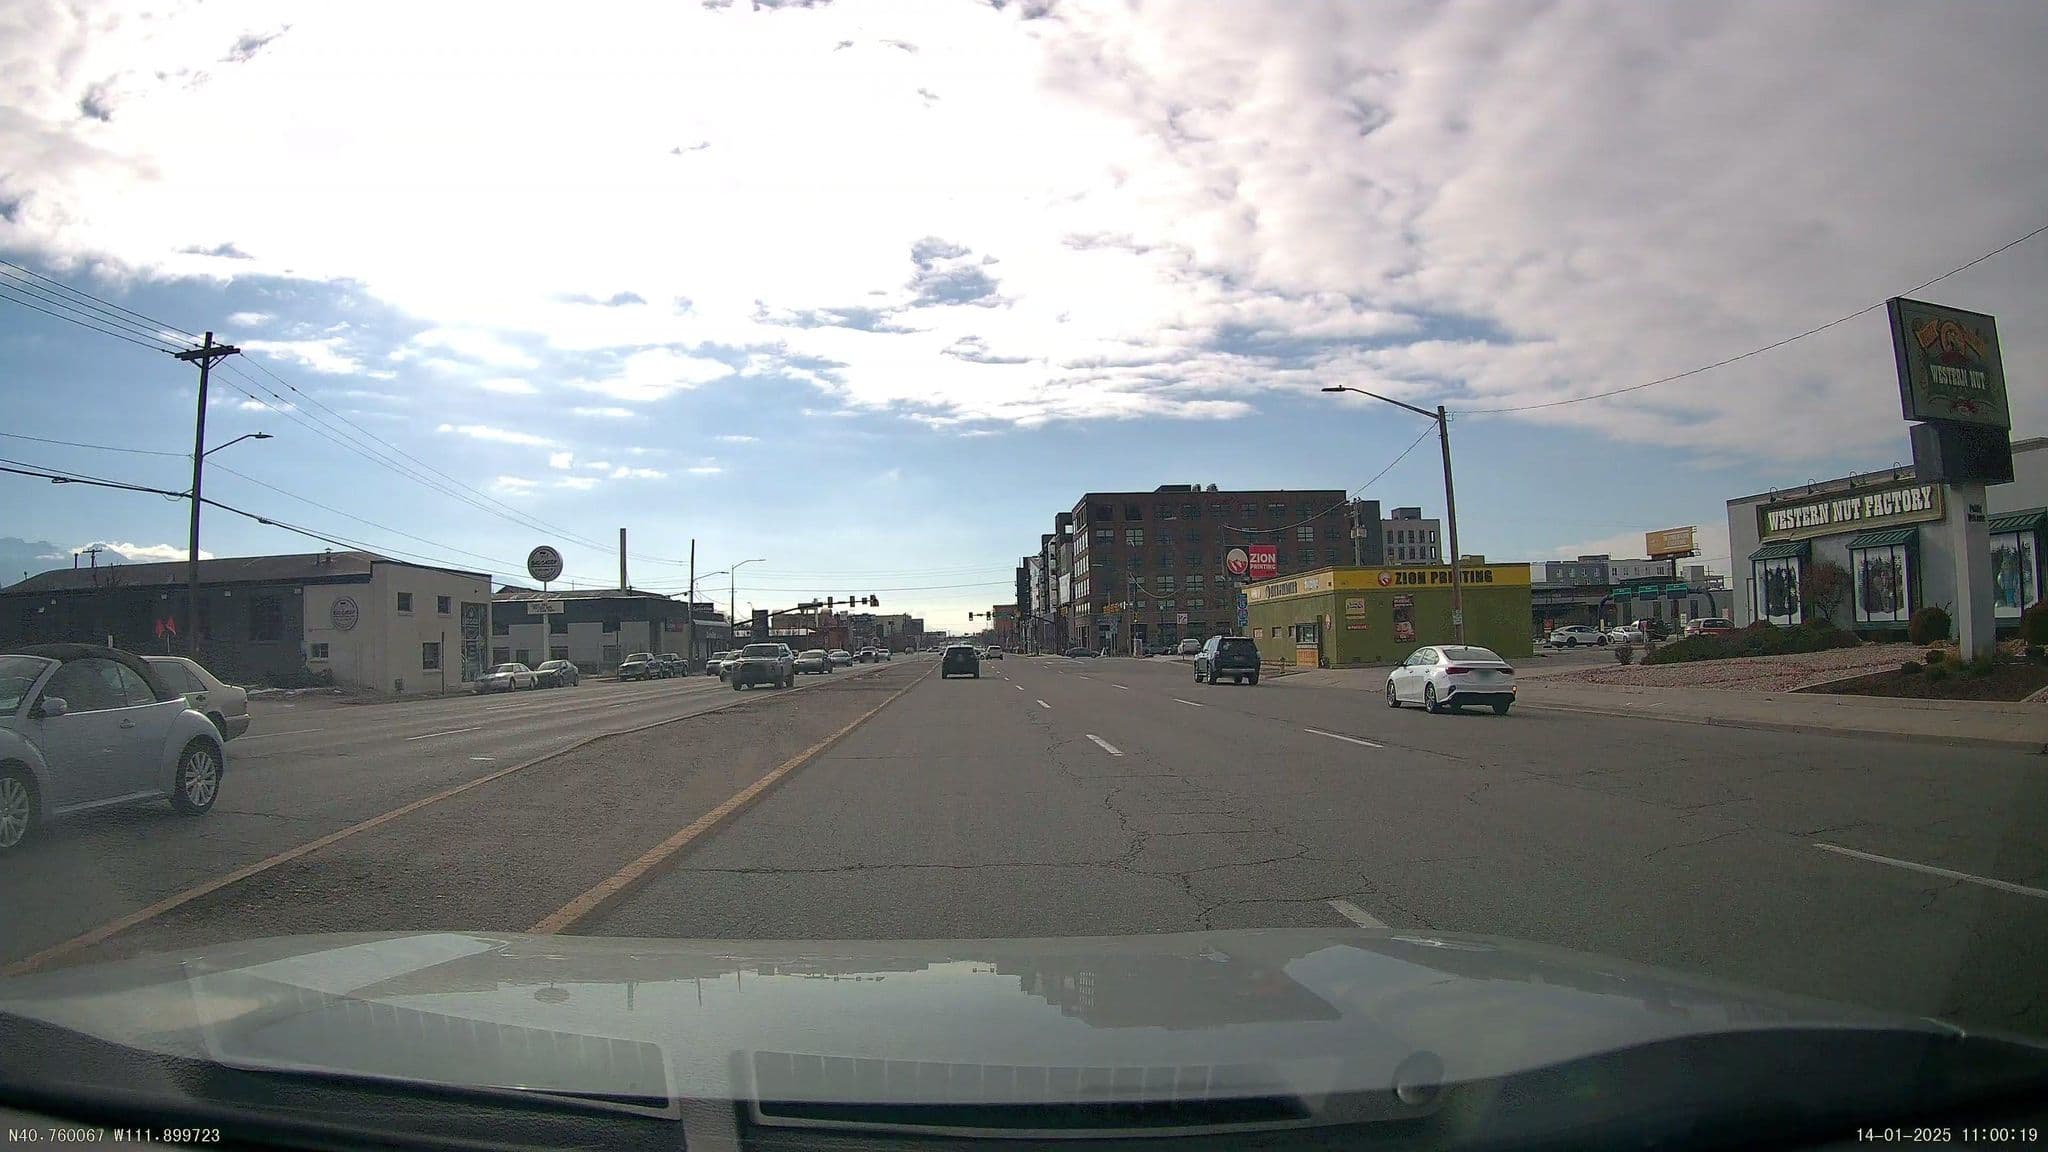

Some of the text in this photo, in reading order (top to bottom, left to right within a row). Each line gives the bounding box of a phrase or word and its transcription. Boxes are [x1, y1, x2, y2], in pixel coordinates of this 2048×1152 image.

[1929, 364, 1986, 390] WESTERN NUT
[1768, 486, 1933, 531] WESTERN NUT FACTORY
[1249, 553, 1276, 564] ZION
[1395, 569, 1493, 585] ZION PRITING
